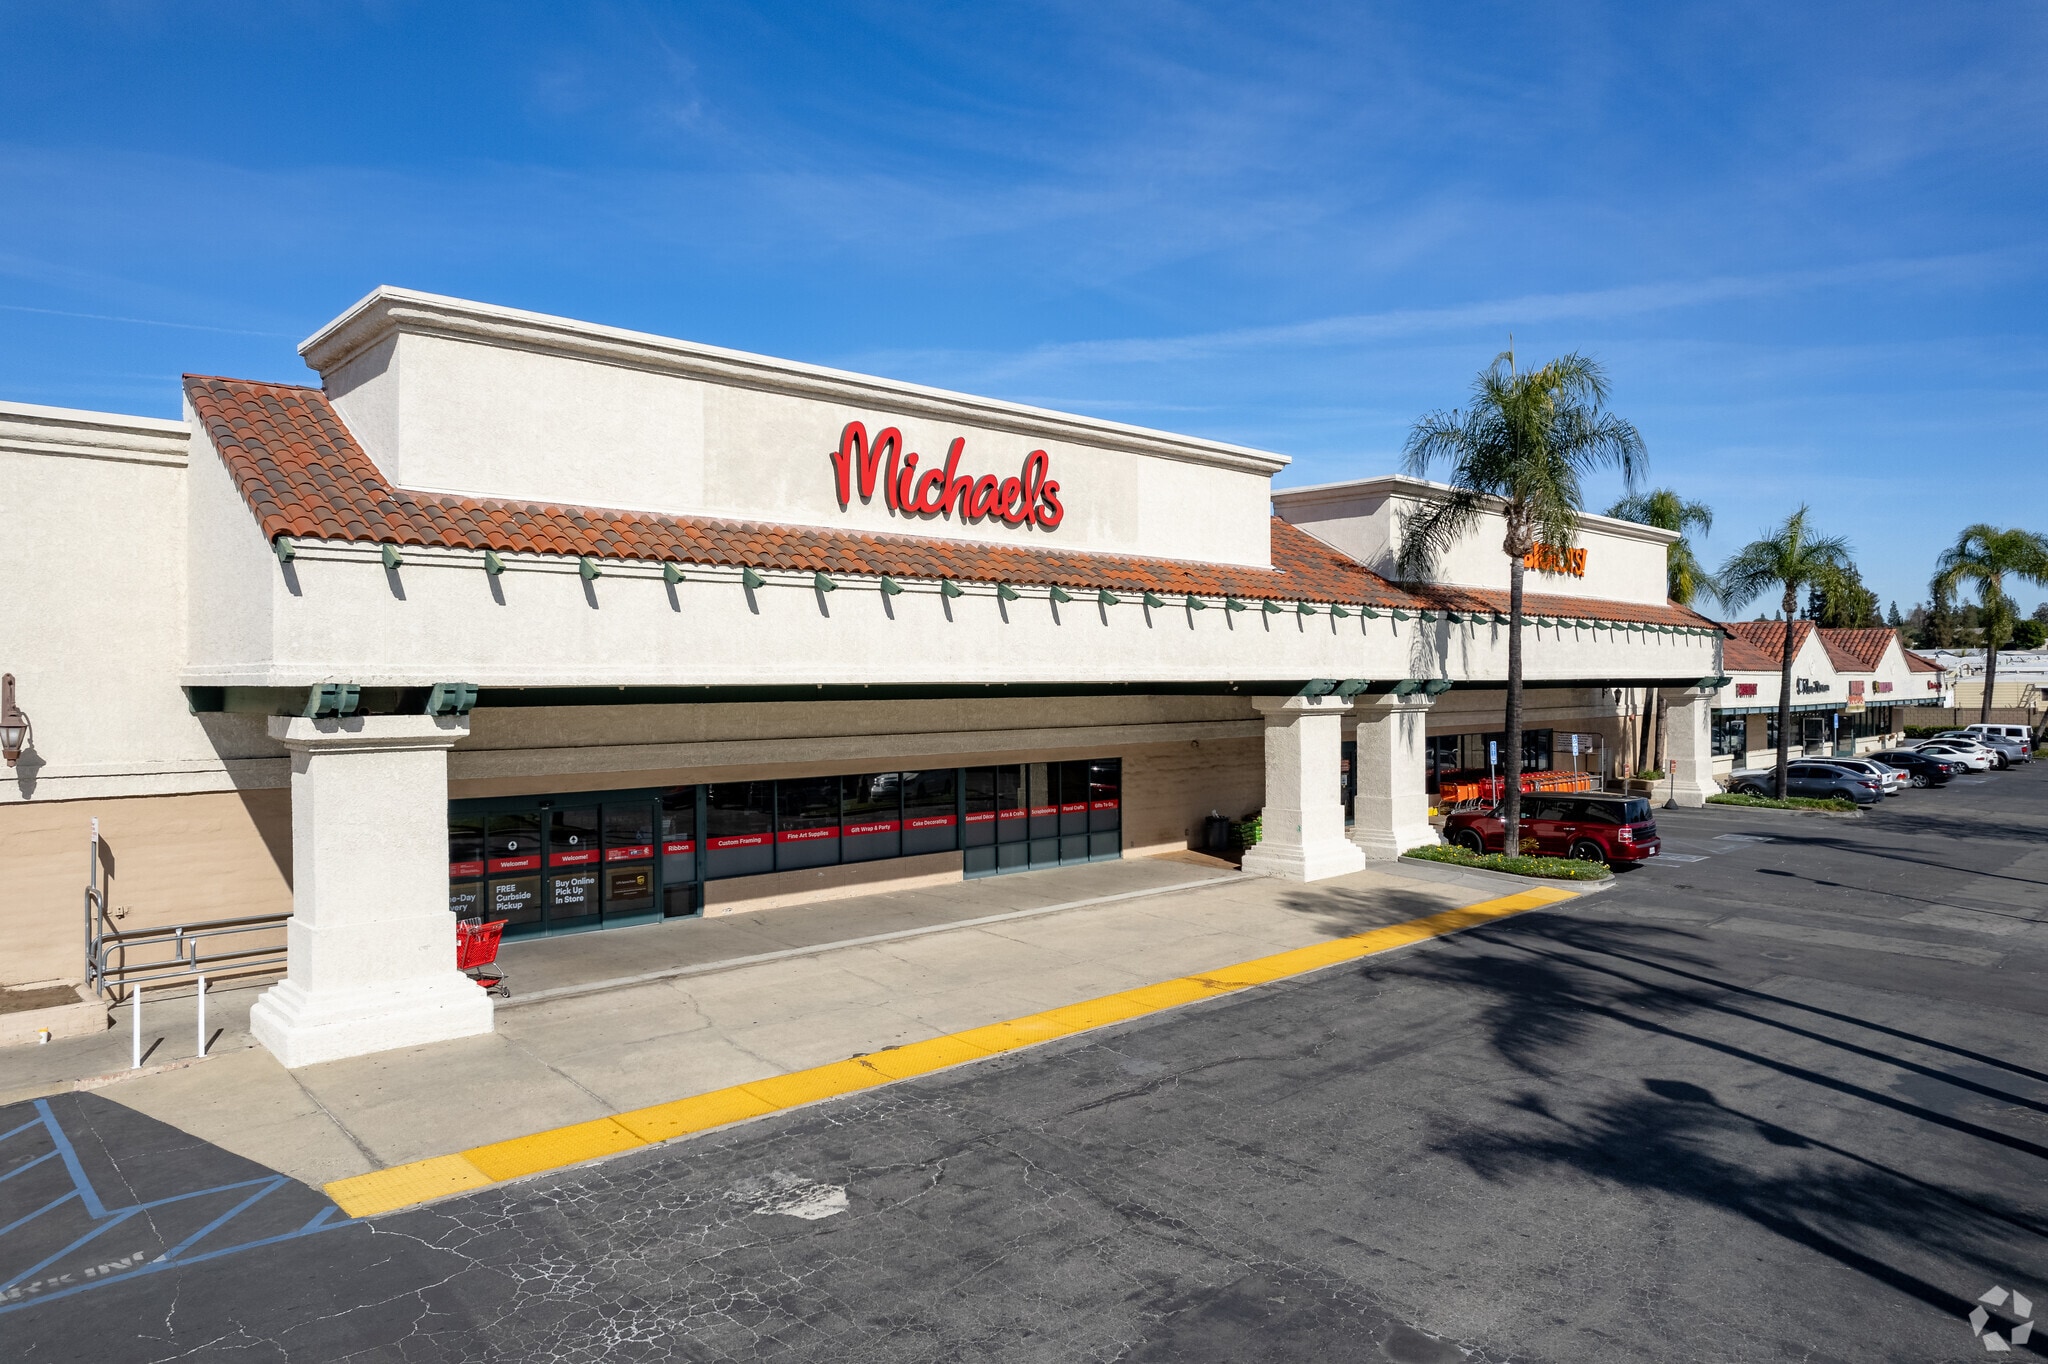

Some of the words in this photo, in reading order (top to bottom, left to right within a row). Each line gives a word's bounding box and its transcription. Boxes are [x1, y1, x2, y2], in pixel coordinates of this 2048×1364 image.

[832, 420, 1064, 526] Michaels
[668, 844, 689, 852] Ribbon
[500, 860, 529, 868] Welcome!
[555, 880, 570, 888] Buy
[571, 877, 595, 886] Online
[496, 884, 516, 893] FREE
[555, 887, 571, 896] Pick
[572, 886, 583, 895] Up
[449, 894, 476, 903] e-Day
[496, 892, 531, 902] Curbside
[555, 896, 563, 904] In
[564, 895, 584, 904] Store
[496, 902, 523, 911] Pickup
